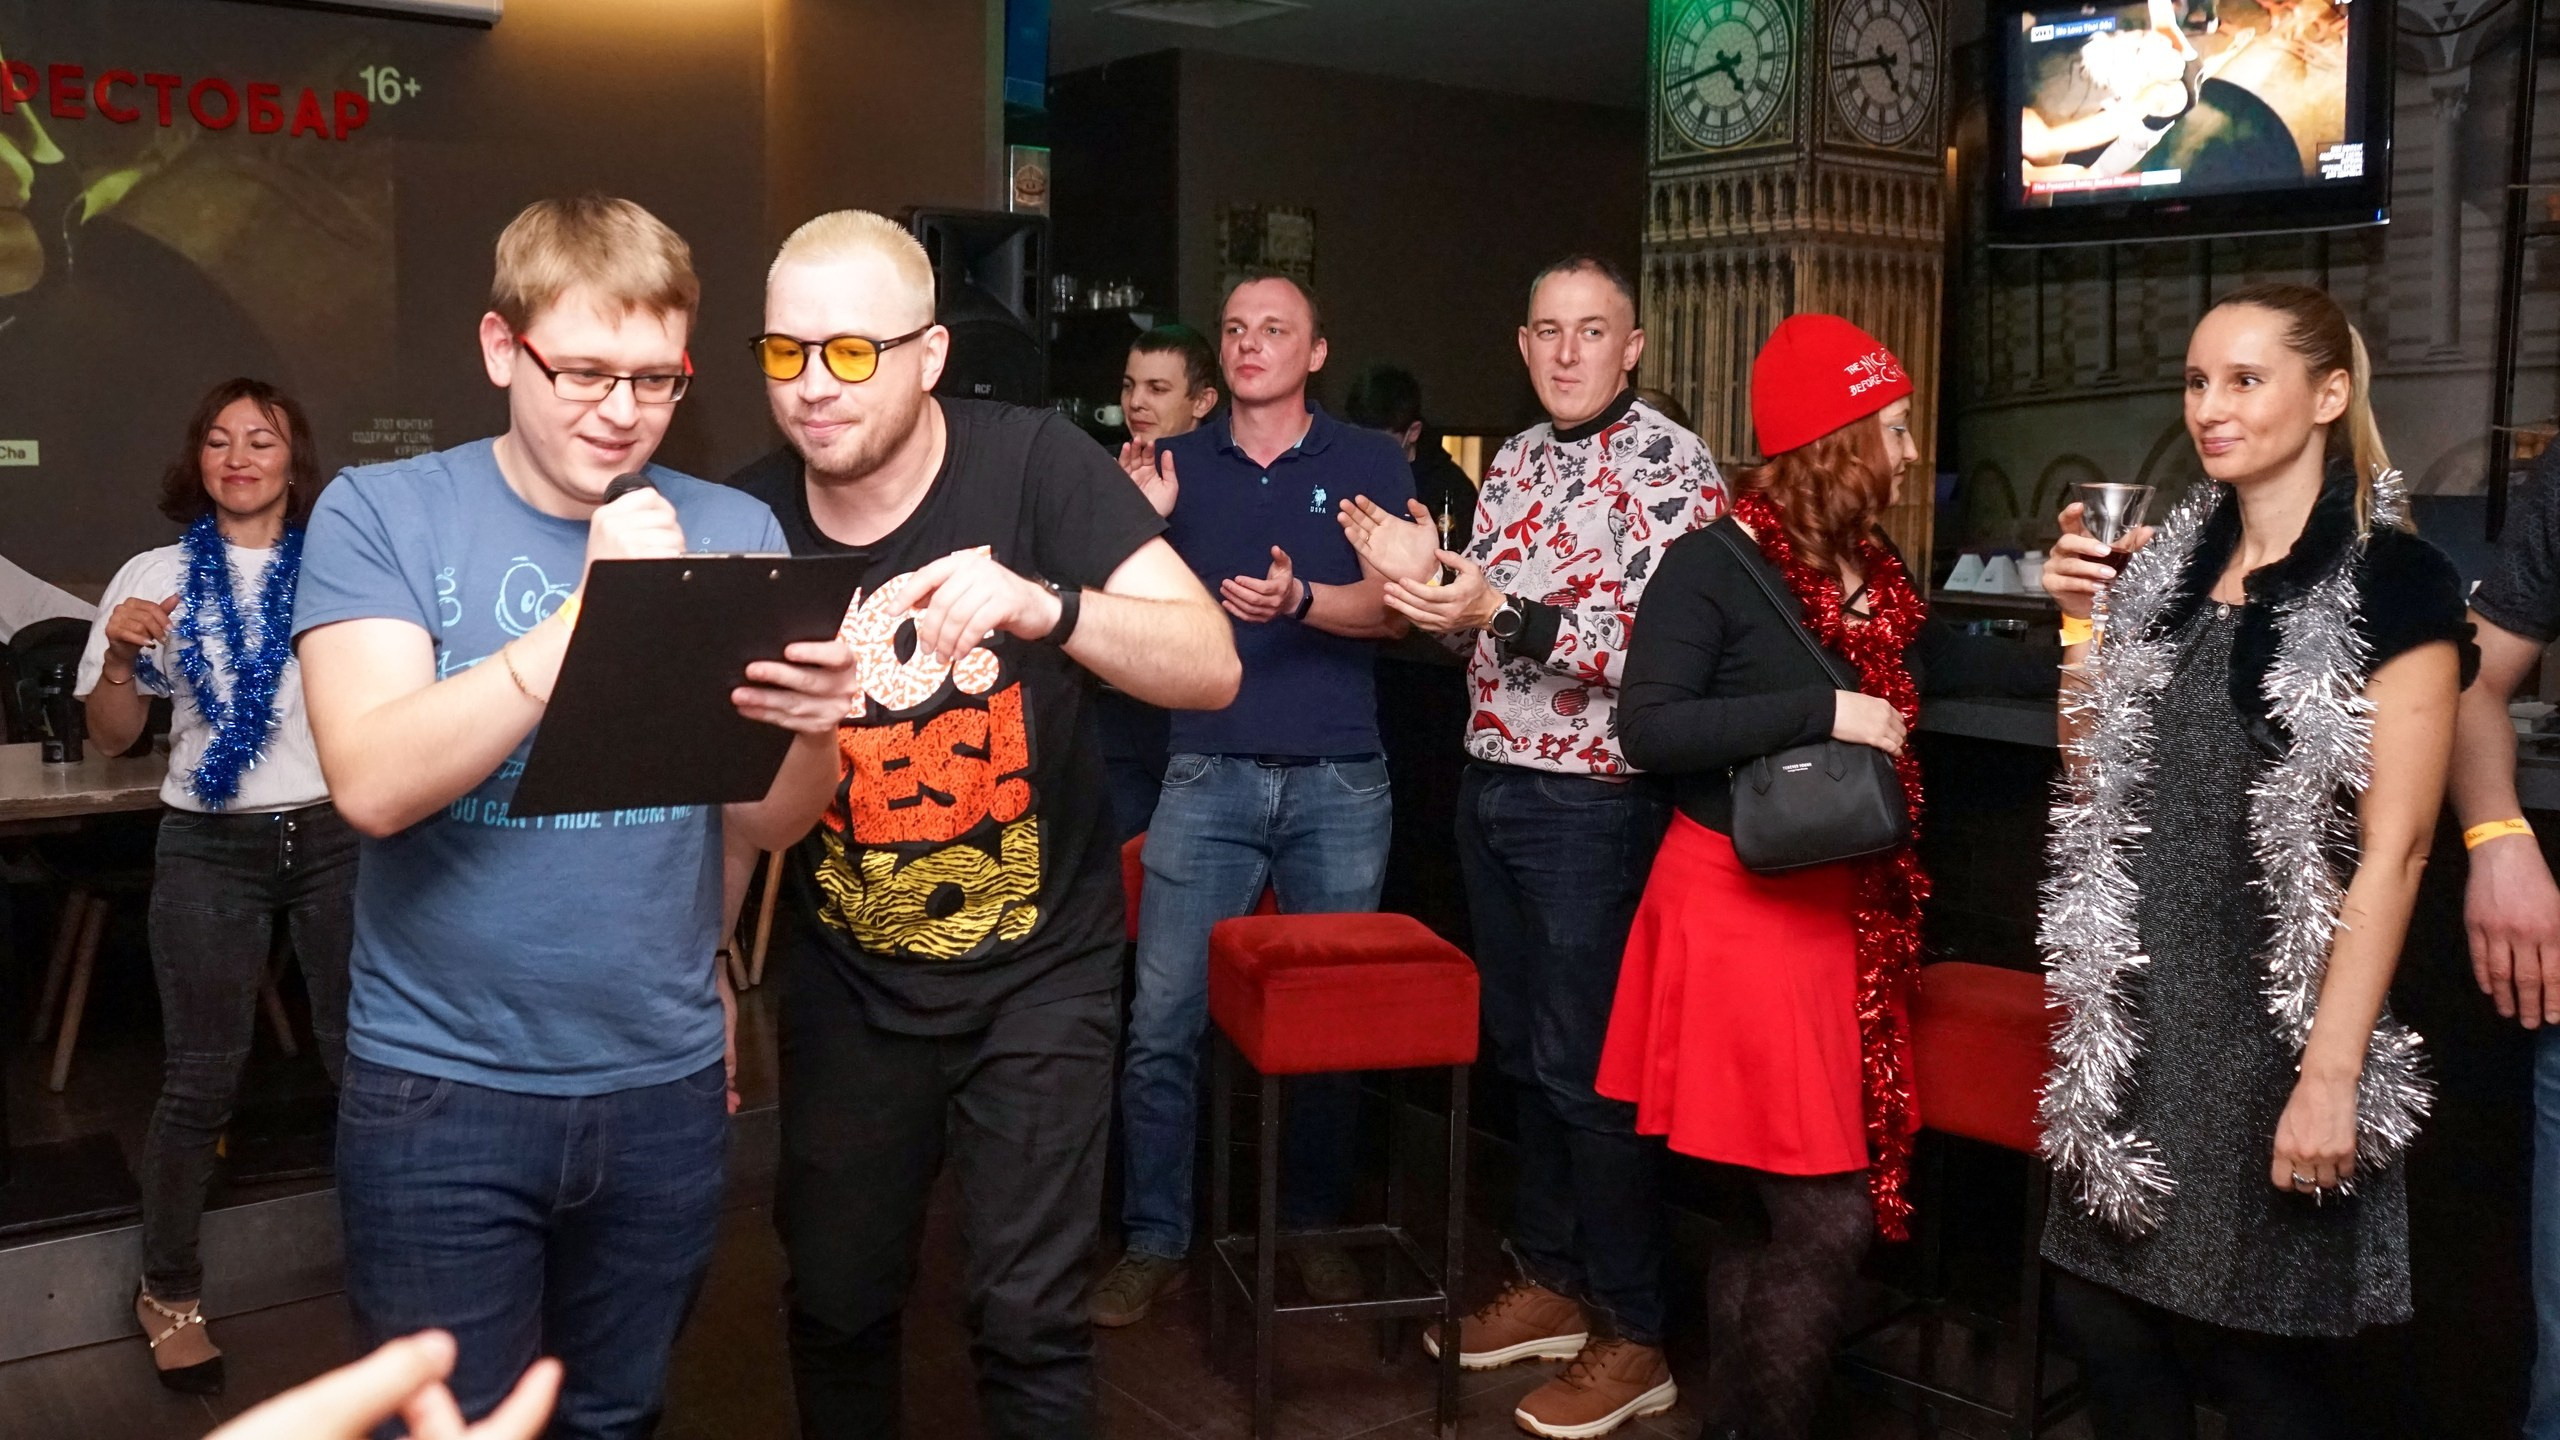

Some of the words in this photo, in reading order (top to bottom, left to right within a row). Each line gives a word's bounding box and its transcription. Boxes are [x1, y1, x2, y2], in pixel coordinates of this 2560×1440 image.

[359, 65, 422, 105] 16+
[1, 60, 371, 142] РЕСТОБАР
[974, 383, 992, 394] RCF
[1849, 374, 1883, 397] BEFORE
[449, 797, 479, 823] OU
